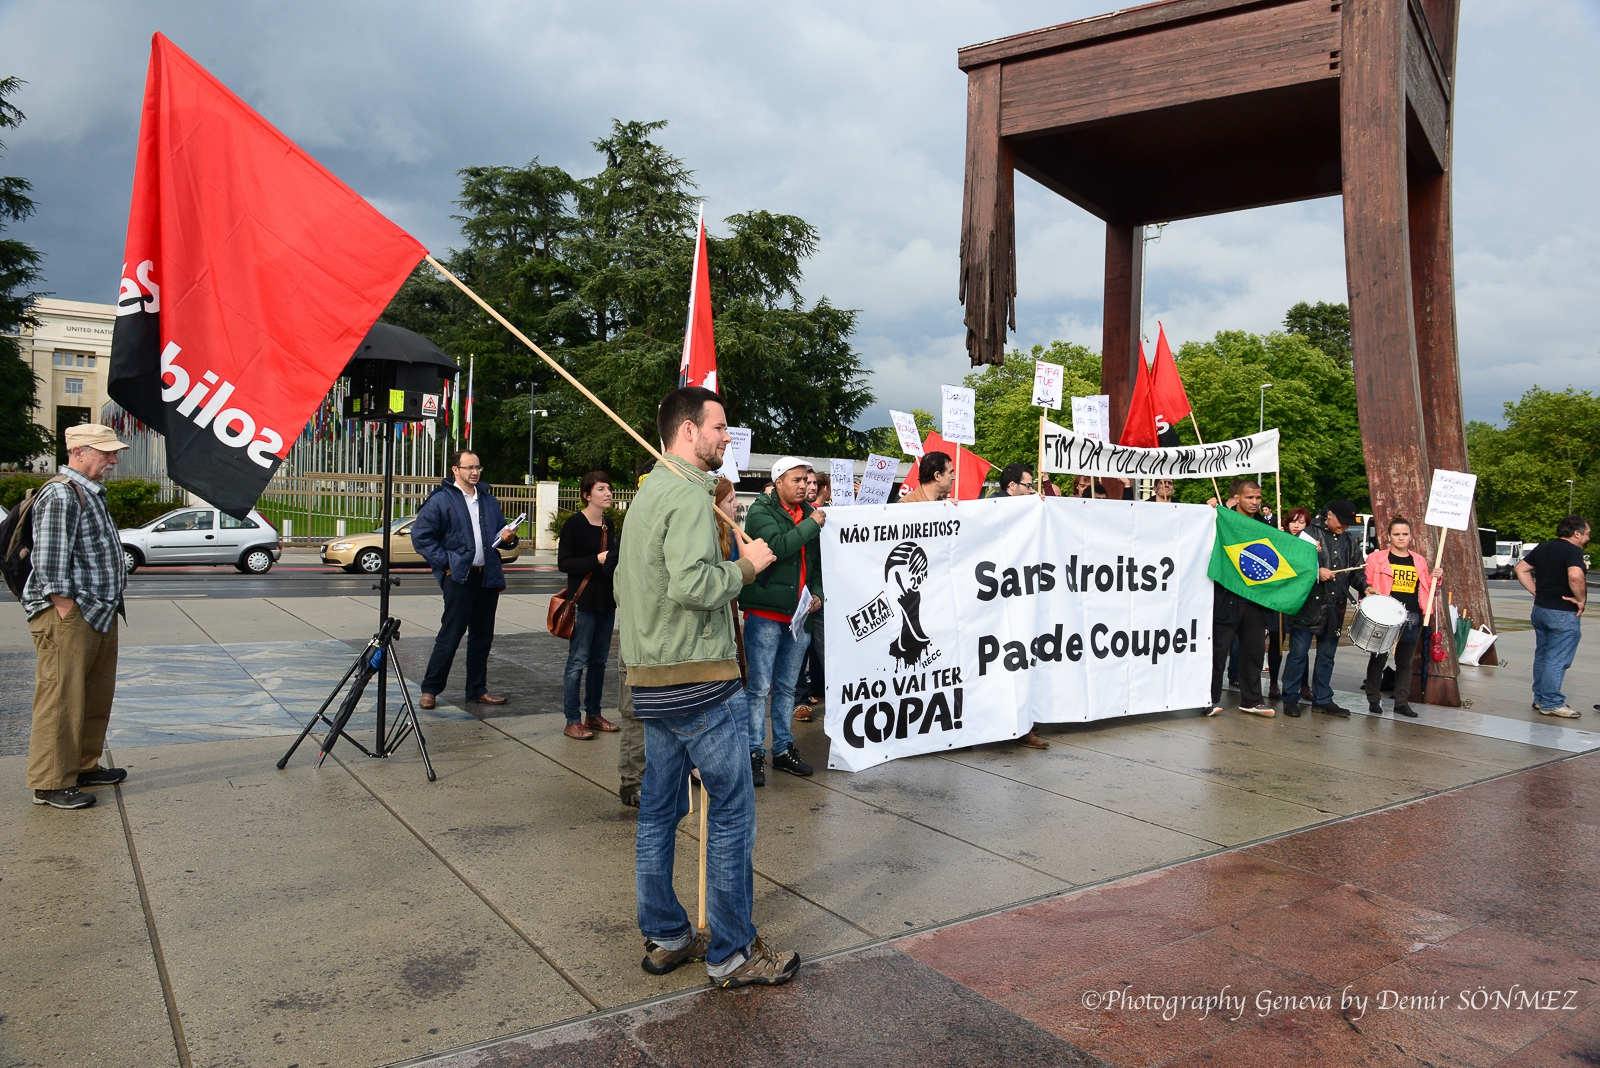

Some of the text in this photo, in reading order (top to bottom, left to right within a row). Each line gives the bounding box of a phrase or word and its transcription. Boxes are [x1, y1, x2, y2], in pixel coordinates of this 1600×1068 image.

[1037, 364, 1060, 377] FIFA
[1037, 375, 1054, 387] TUE
[1079, 438, 1103, 470] DA
[839, 519, 961, 544] NÃO TEM DIREITOS?
[910, 570, 928, 590] 2014
[975, 554, 1175, 601] Sans droits?
[1393, 569, 1416, 582] FREE
[850, 598, 889, 631] FIFA
[856, 608, 891, 637] GO HOME
[1037, 624, 1083, 662] de
[1091, 619, 1198, 665] Coupe!
[922, 649, 942, 669] RECC
[841, 666, 963, 704] NÃO VAI TER
[843, 688, 964, 749] COPA!
